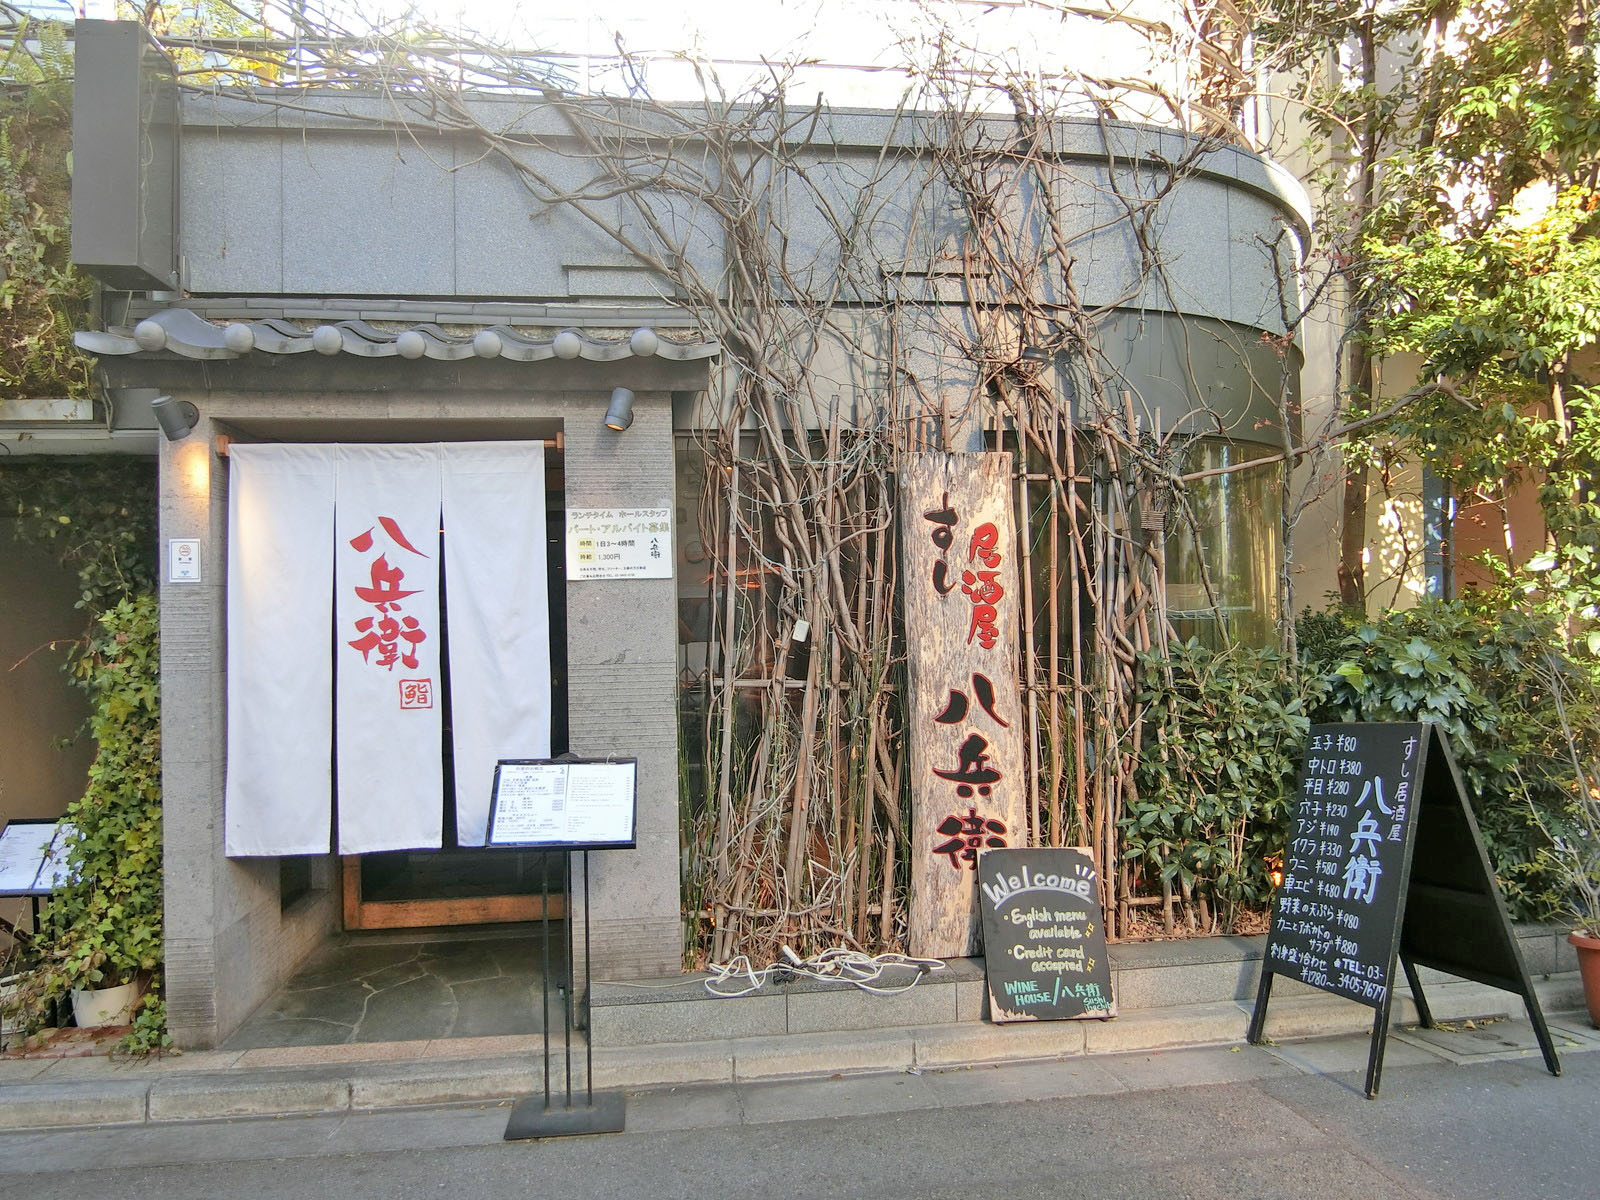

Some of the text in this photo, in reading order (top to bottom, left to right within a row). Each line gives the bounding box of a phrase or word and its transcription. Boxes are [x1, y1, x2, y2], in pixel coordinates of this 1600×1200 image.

[619, 510, 667, 518] ホールスタッフ
[923, 491, 959, 596] すし
[348, 516, 431, 671] 八兵衛
[961, 522, 1005, 651] 居酒屋
[404, 684, 428, 704] 鮨
[1310, 733, 1357, 752] 玉子 ¥80
[1308, 757, 1362, 776] 中トロ ¥380
[1303, 778, 1350, 795] 平目 ¥280
[1387, 736, 1418, 842] すし居酒屋
[1299, 799, 1348, 818] 穴子 ¥230
[1296, 818, 1340, 836] アジ ¥190
[1291, 837, 1342, 858] イクラ ¥330
[1341, 775, 1392, 904] 八兵衛
[1289, 855, 1338, 876] ウニ ¥580
[982, 865, 1091, 903] Welcome
[1317, 880, 1341, 898] ¥480
[1010, 906, 1088, 929] English menu
[1279, 897, 1360, 930] 野菜の天ぷら ¥980
[1028, 924, 1082, 940] available
[1013, 944, 1085, 960] Credit card
[1308, 934, 1358, 956] サラダ ¥880
[1031, 959, 1083, 975] accepted
[1270, 942, 1328, 972] 刺身盛り合わせ
[1004, 980, 1039, 996] WINE
[1337, 972, 1387, 1004] 3405-7677
[1015, 991, 1052, 1007] HOUSE
